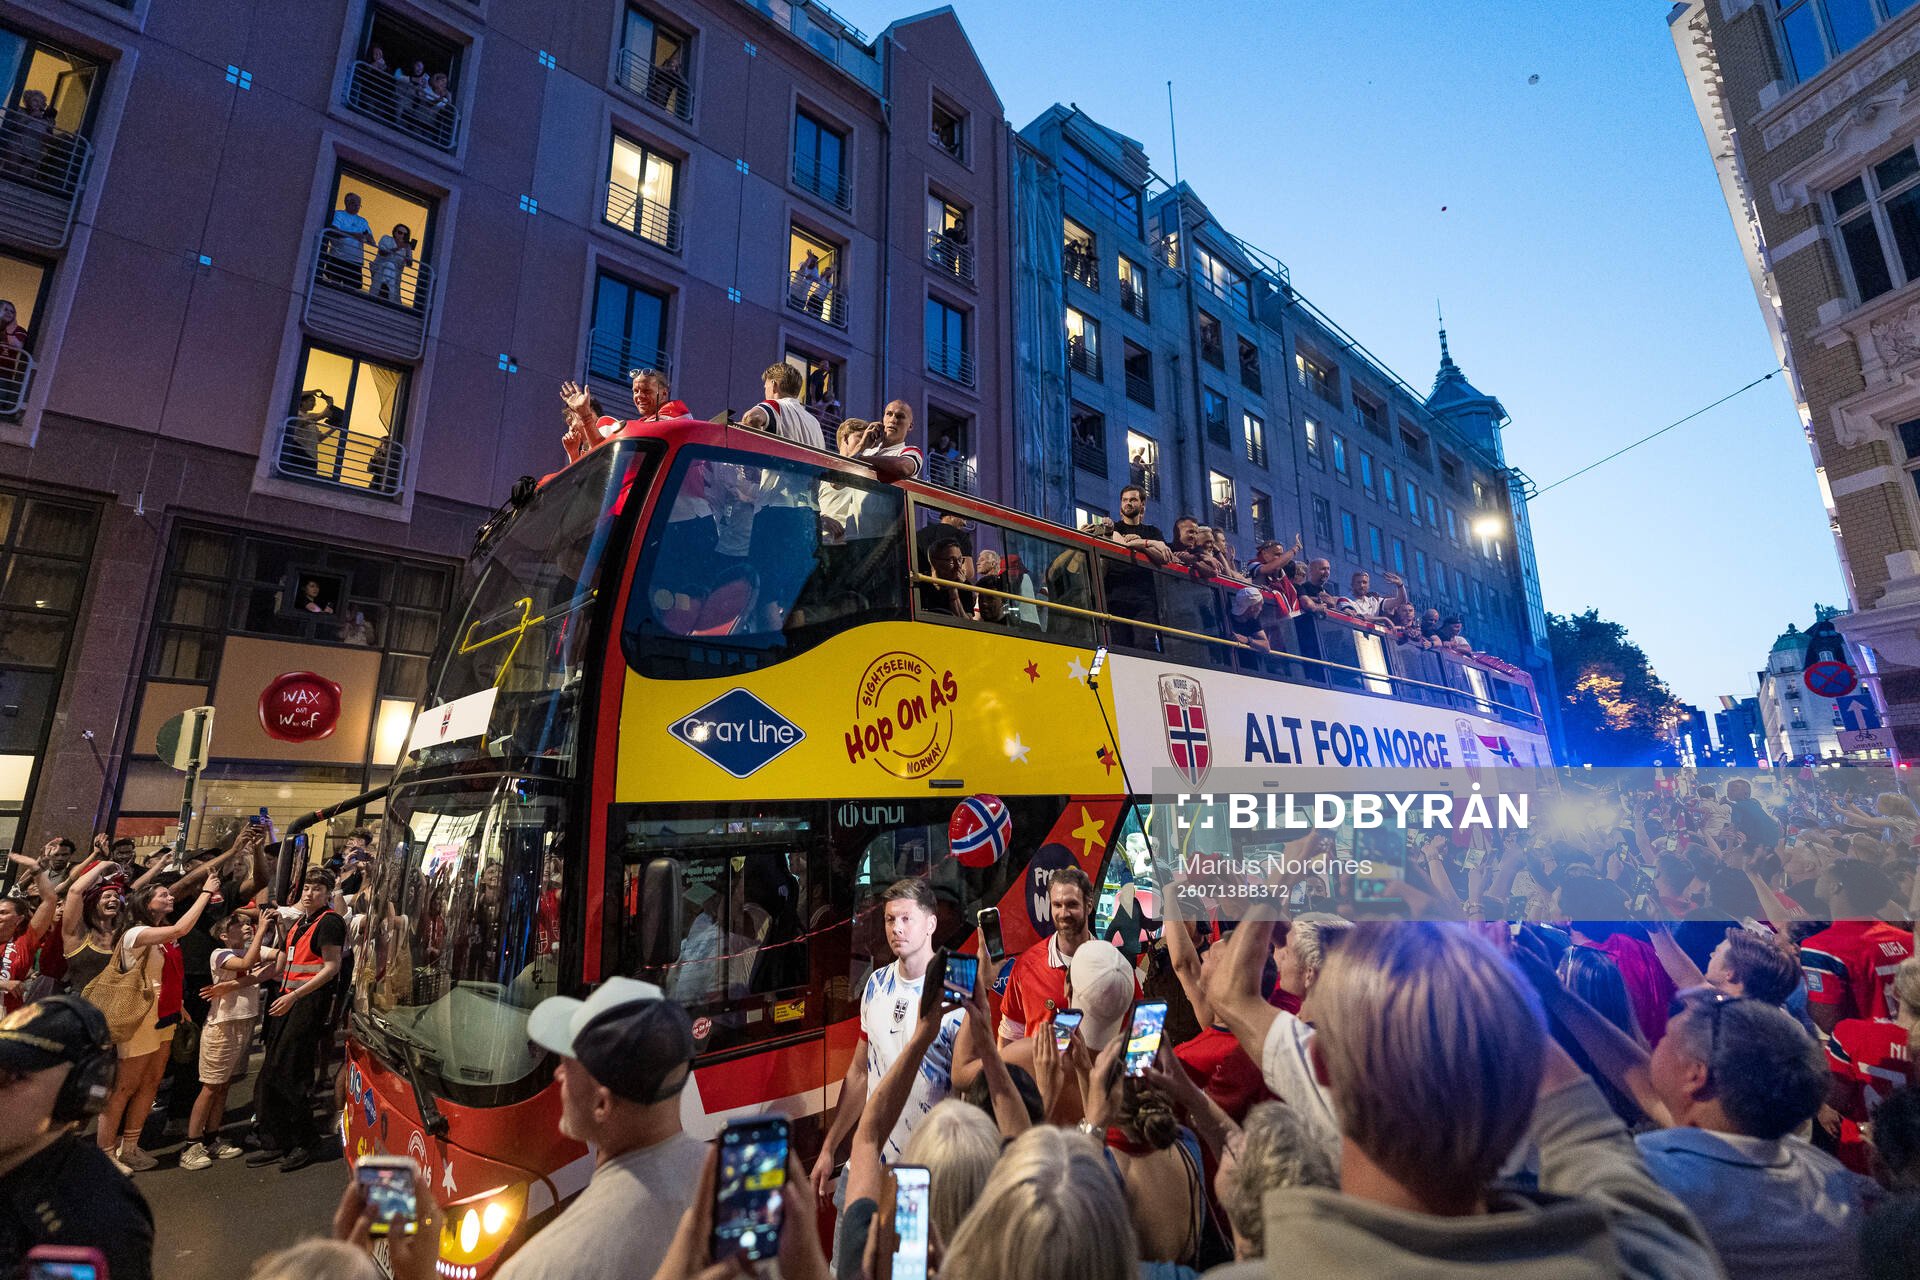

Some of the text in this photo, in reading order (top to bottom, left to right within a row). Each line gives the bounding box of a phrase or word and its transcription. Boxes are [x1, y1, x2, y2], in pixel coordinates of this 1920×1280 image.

[283, 689, 320, 704] WAX
[863, 659, 922, 706] SIGHTSEEING
[897, 695, 928, 730] On
[930, 670, 958, 713] AS
[749, 719, 794, 743] Line
[1245, 712, 1452, 769] ALT FOR NORGE
[906, 742, 942, 774] NORWAY
